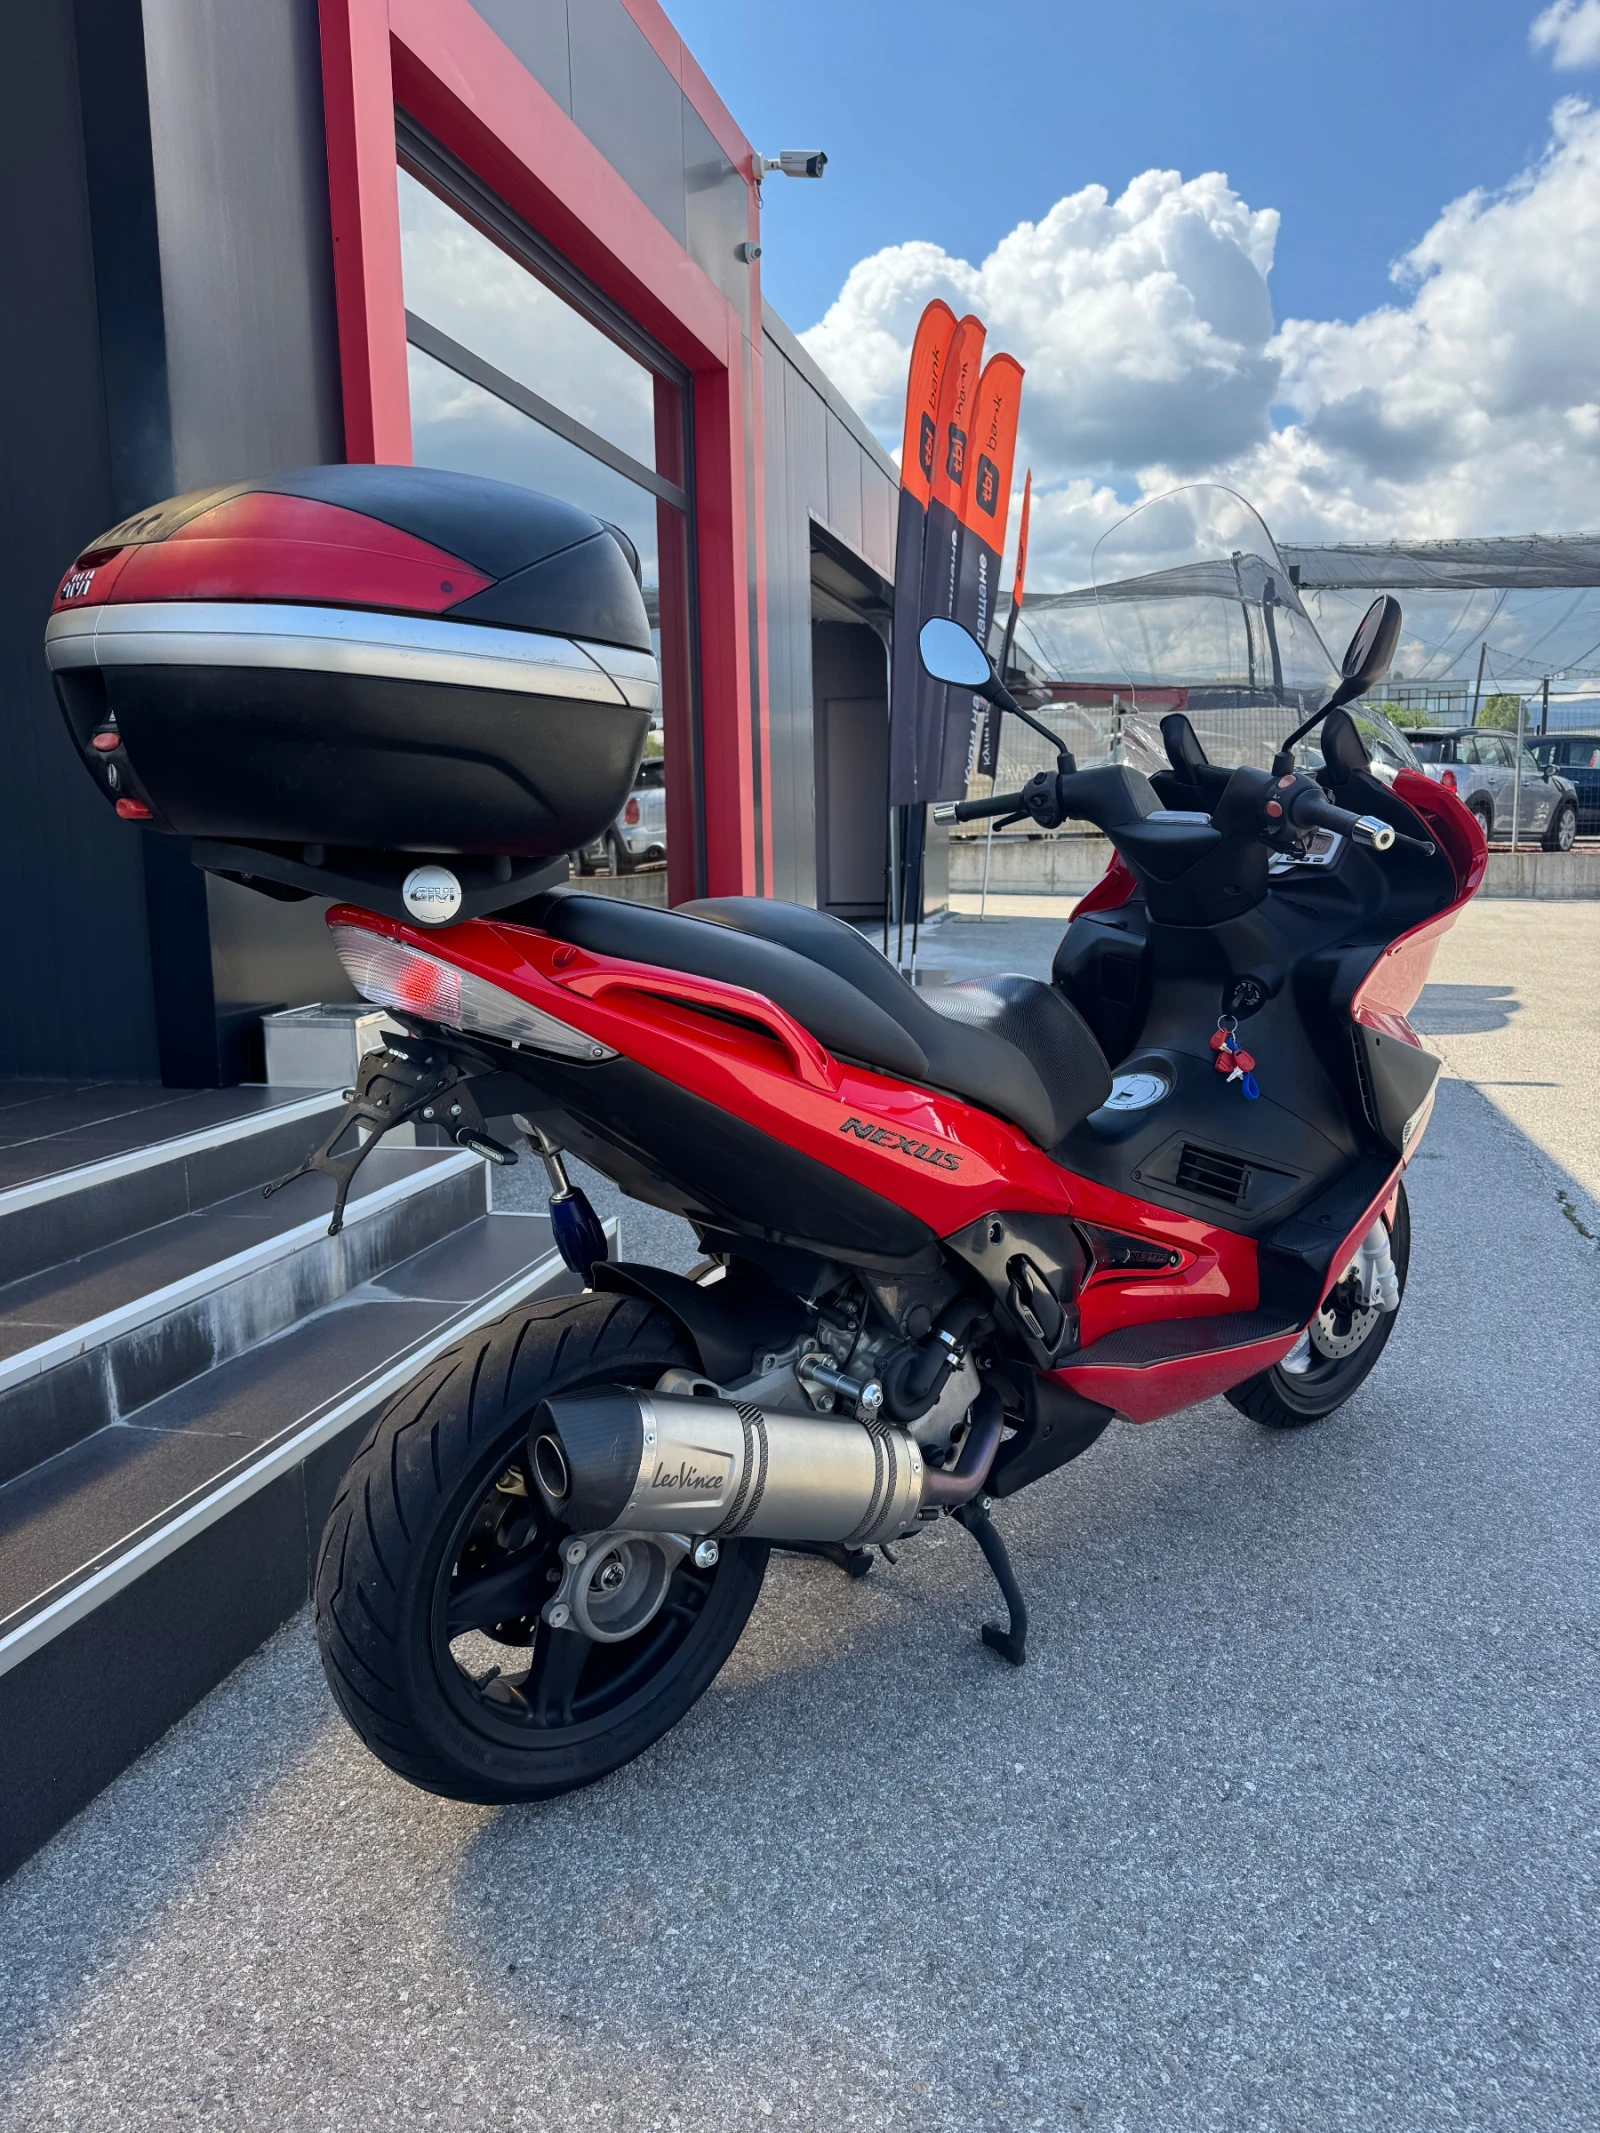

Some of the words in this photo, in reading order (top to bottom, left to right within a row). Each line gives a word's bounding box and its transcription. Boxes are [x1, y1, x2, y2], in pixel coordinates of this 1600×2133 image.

[928, 344, 940, 411] bank
[986, 393, 1003, 452] bank
[924, 427, 934, 467] tbi
[951, 436, 963, 473] tbi
[981, 466, 993, 501] tbi
[410, 886, 456, 904] GIVI
[838, 1116, 964, 1172] NEXUS
[651, 1461, 724, 1490] LeoVince
